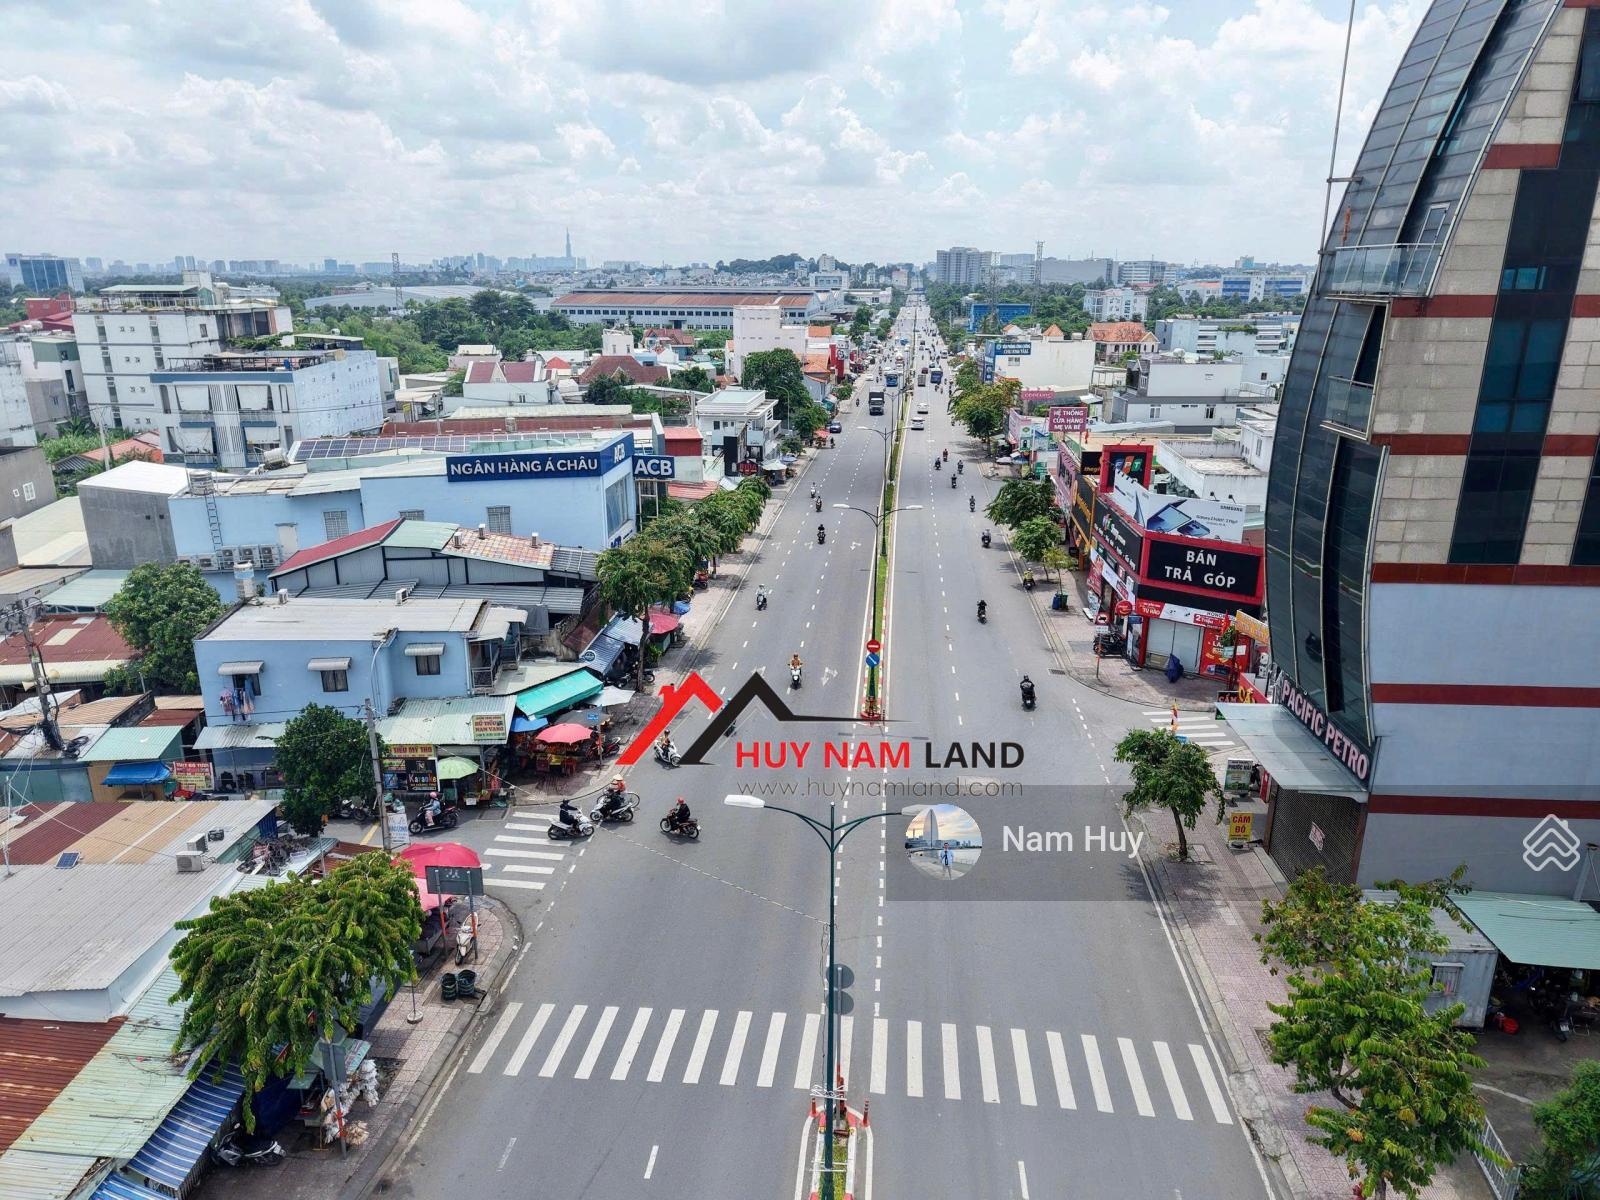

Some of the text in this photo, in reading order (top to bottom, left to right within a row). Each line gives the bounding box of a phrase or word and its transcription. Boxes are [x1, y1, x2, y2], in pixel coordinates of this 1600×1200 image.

[614, 443, 626, 464] ACB
[450, 456, 598, 475] NGÂN HÀNG Á CHÂU
[634, 459, 673, 476] ACB
[1186, 550, 1217, 567] BÁN
[1164, 565, 1236, 589] TRẢ GÓP
[1281, 680, 1369, 780] PACIFIC PETRO
